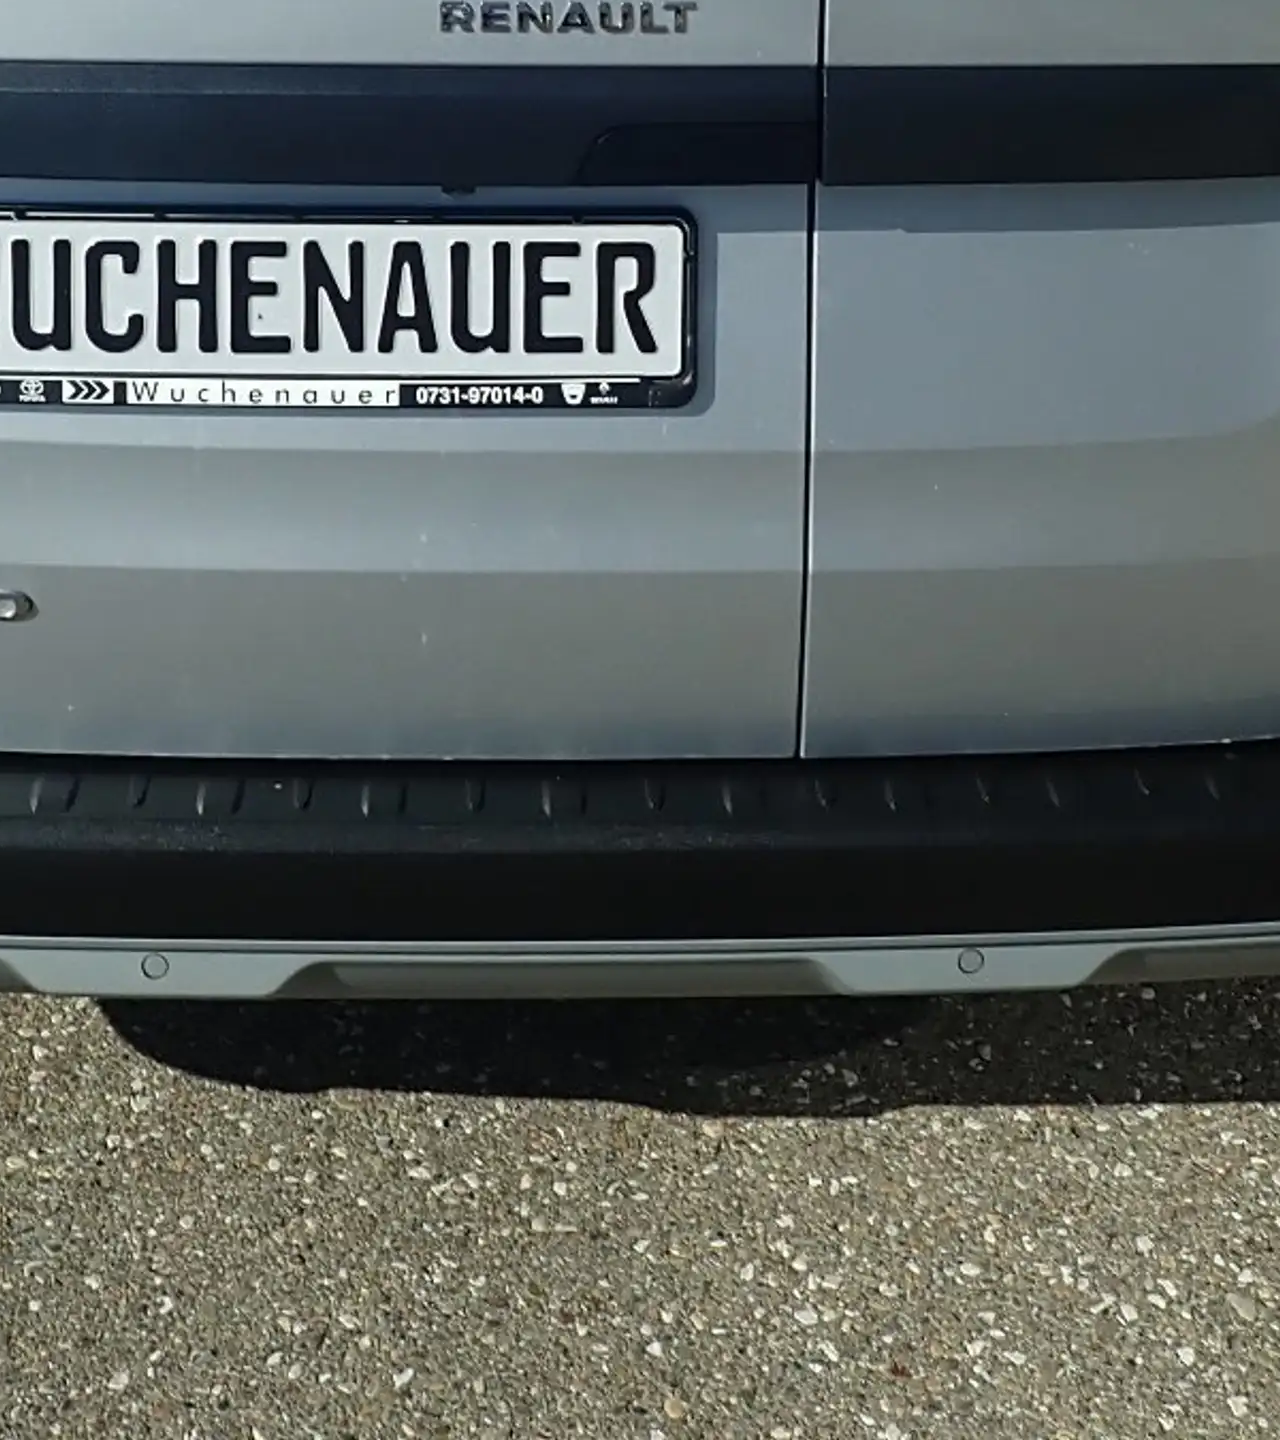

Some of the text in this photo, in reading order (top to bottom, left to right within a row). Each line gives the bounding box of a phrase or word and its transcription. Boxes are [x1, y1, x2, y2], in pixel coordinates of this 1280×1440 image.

[439, 0, 698, 34] RENAULT
[131, 380, 398, 404] Wuchenauer
[416, 386, 544, 405] 0731-97014-0
